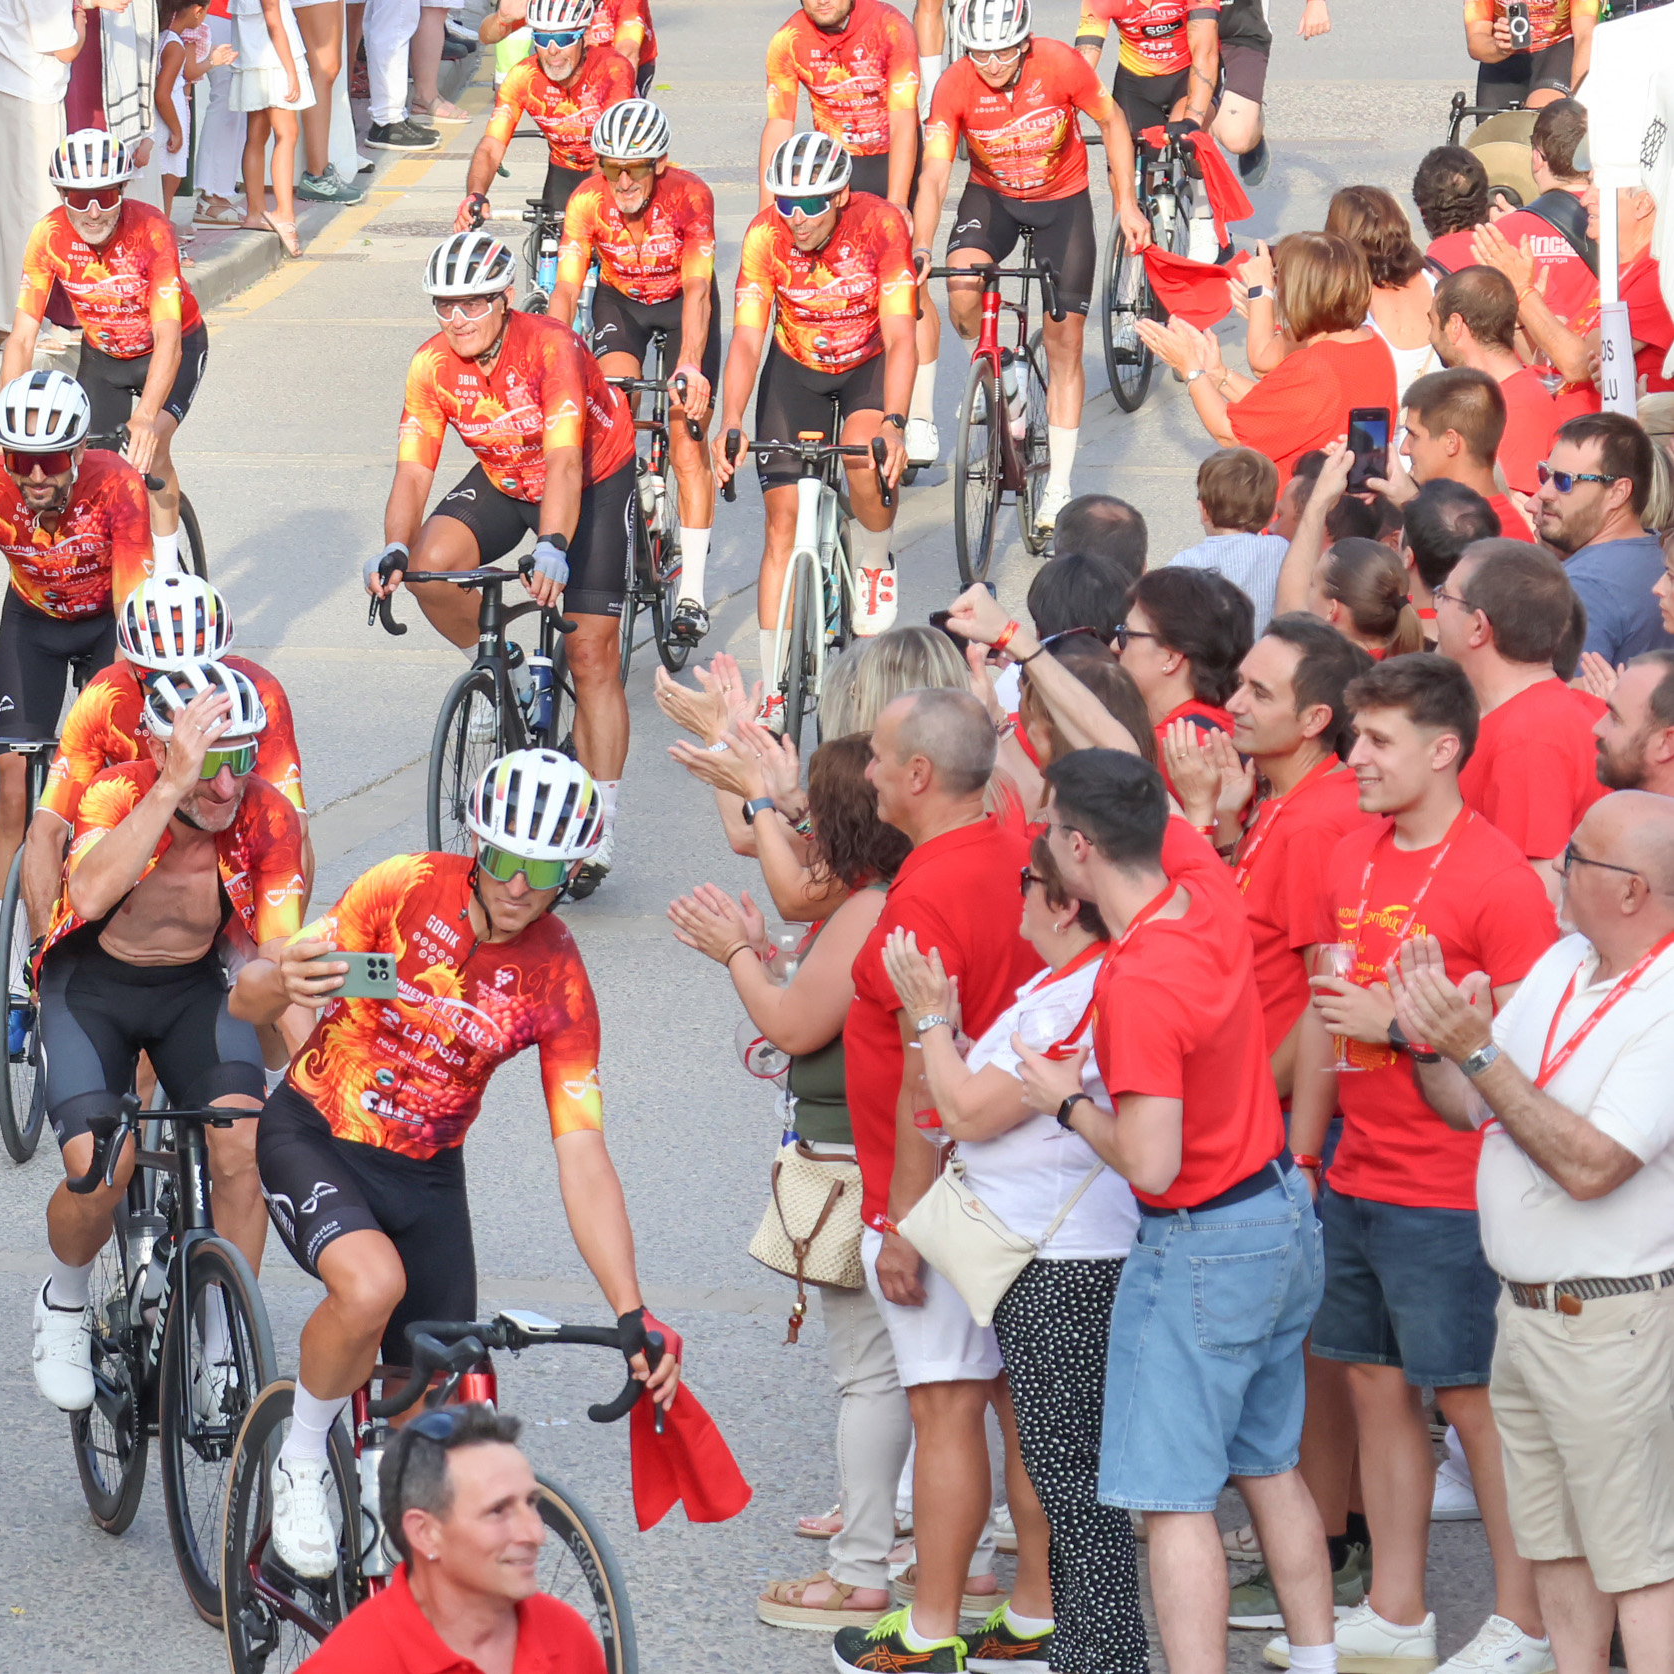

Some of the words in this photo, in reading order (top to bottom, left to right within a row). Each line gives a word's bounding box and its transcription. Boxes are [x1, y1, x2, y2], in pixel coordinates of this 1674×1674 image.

[851, 96, 878, 107] Rioja
[984, 135, 1052, 154] cantabria
[1529, 235, 1576, 254] inca
[643, 265, 674, 274] Rioja
[95, 303, 108, 312] La
[110, 303, 140, 314] Rioja
[833, 304, 867, 319] Rioja
[503, 412, 543, 431] ULTREY
[512, 443, 543, 456] Rioj
[44, 568, 60, 577] La
[63, 562, 99, 576] Rioja
[479, 634, 497, 642] BH
[425, 914, 460, 948] GOBIK
[396, 977, 443, 1011] IMIENTO
[441, 1004, 504, 1053] ULTREYA
[376, 1036, 398, 1054] red
[402, 1023, 423, 1043] La
[424, 1034, 465, 1066] Rioja
[398, 1080, 416, 1095] LAND
[417, 1088, 433, 1102] LIFE
[194, 1164, 203, 1210] MMR
[228, 1486, 239, 1552] SWISS
[570, 1530, 602, 1593] SWISS
